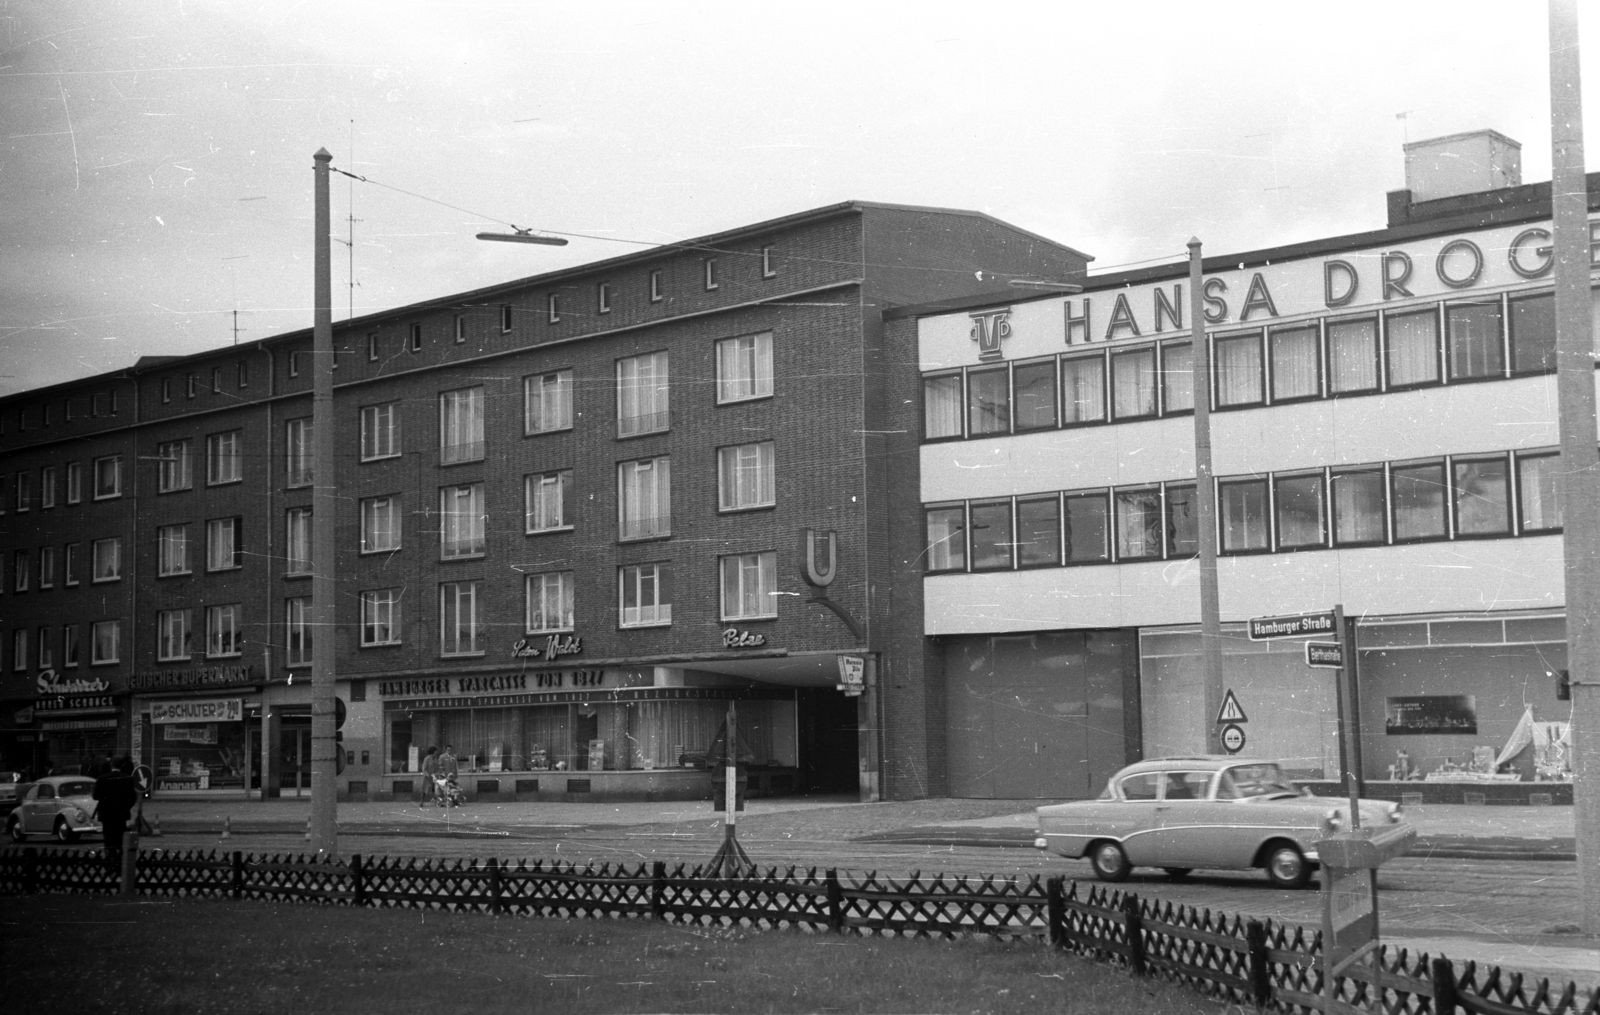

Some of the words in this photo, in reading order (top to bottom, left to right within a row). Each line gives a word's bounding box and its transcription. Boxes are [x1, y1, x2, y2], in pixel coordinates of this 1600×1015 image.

[1063, 271, 1279, 345] HANSA
[800, 527, 837, 587] U
[1254, 621, 1300, 635] Hamburger
[1302, 616, 1331, 631] Straße
[722, 628, 765, 647] Pelze
[511, 638, 540, 658] Salon
[124, 669, 179, 689] DEUTSCHER
[181, 665, 251, 685] SUPERMARKT
[379, 678, 450, 696] HAMBURGER
[457, 672, 527, 692] SPARCASSE
[535, 672, 563, 688] VON
[571, 670, 605, 687] 1827
[415, 698, 472, 709] HAMBURGER
[477, 695, 532, 706] SPARCASSE
[538, 693, 558, 703] VON
[565, 692, 590, 701] 1827
[168, 702, 216, 719] SCHULTER
[159, 780, 197, 791] Ananas
